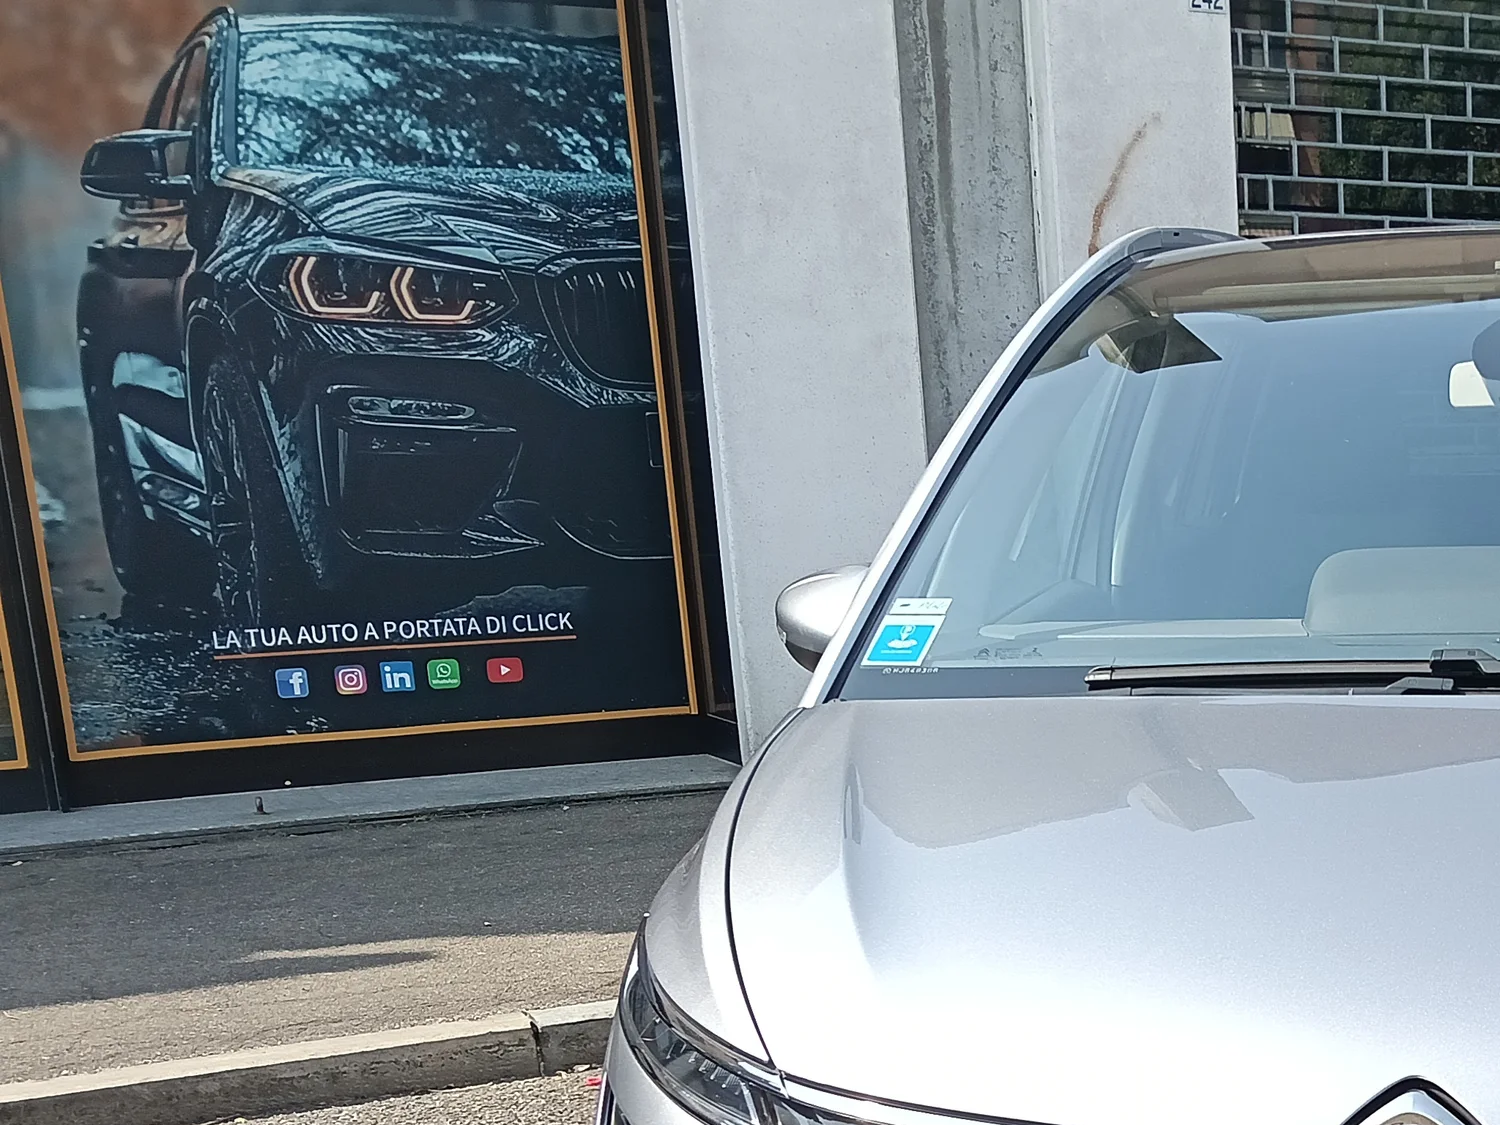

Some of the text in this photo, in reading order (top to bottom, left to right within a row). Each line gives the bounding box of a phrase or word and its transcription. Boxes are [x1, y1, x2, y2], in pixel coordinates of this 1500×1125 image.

[211, 612, 574, 650] LA TUA AUTO A PORTATA DI CLICK
